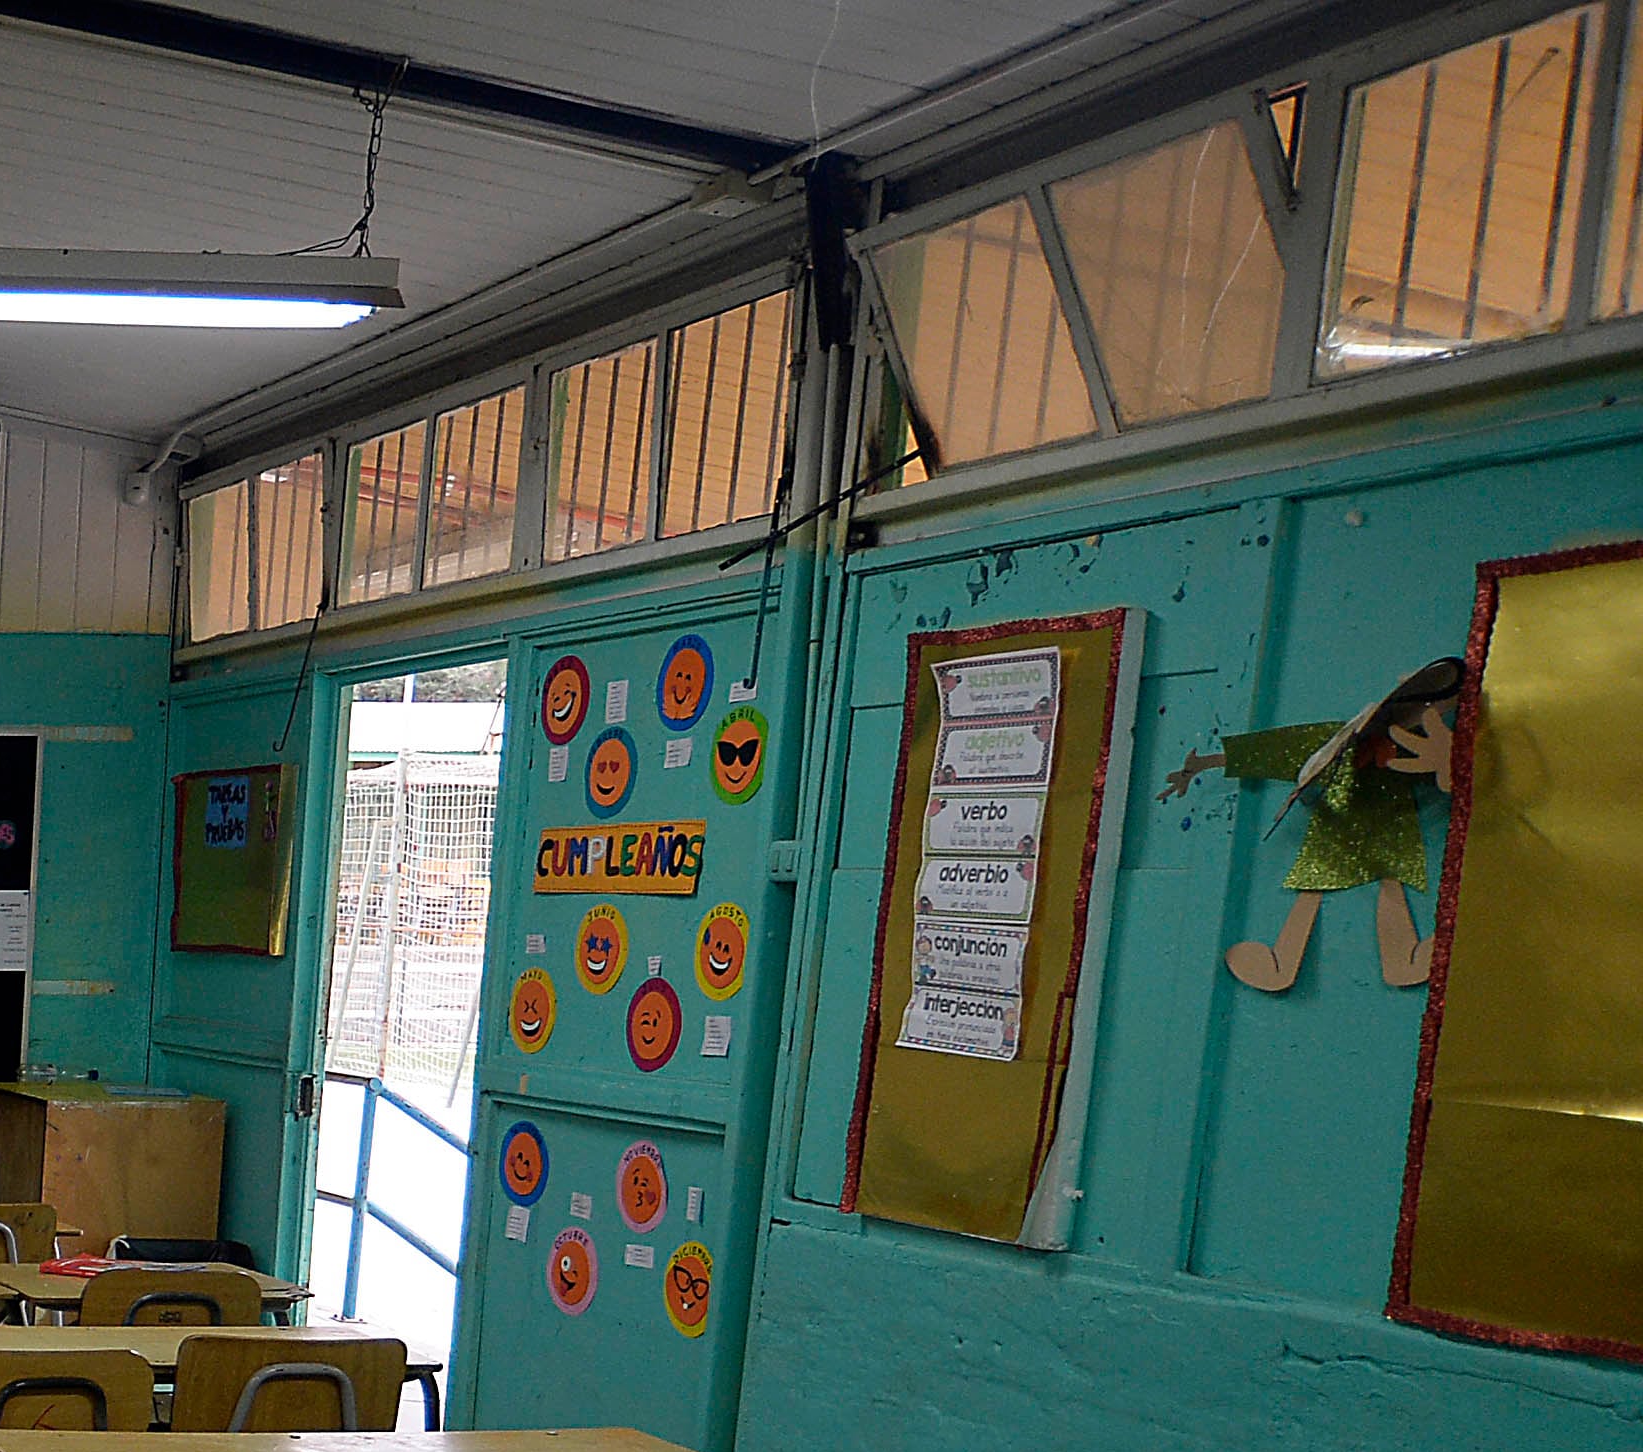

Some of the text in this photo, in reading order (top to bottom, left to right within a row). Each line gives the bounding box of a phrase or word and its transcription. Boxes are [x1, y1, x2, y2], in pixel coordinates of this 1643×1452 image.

[720, 708, 756, 728] ABRIL
[964, 730, 1025, 753] adjetivo
[208, 783, 246, 805] TAREAS
[220, 805, 229, 823] Y
[961, 801, 1008, 820] verbo
[205, 817, 245, 844] PRUEBAS
[537, 826, 704, 877] CUMPLEAÑOS
[939, 863, 1009, 884] adverbio
[587, 907, 616, 921] JUNIO
[708, 906, 744, 928] AGOSTO
[934, 935, 1007, 958] conjunción
[923, 992, 1004, 1021] interjección
